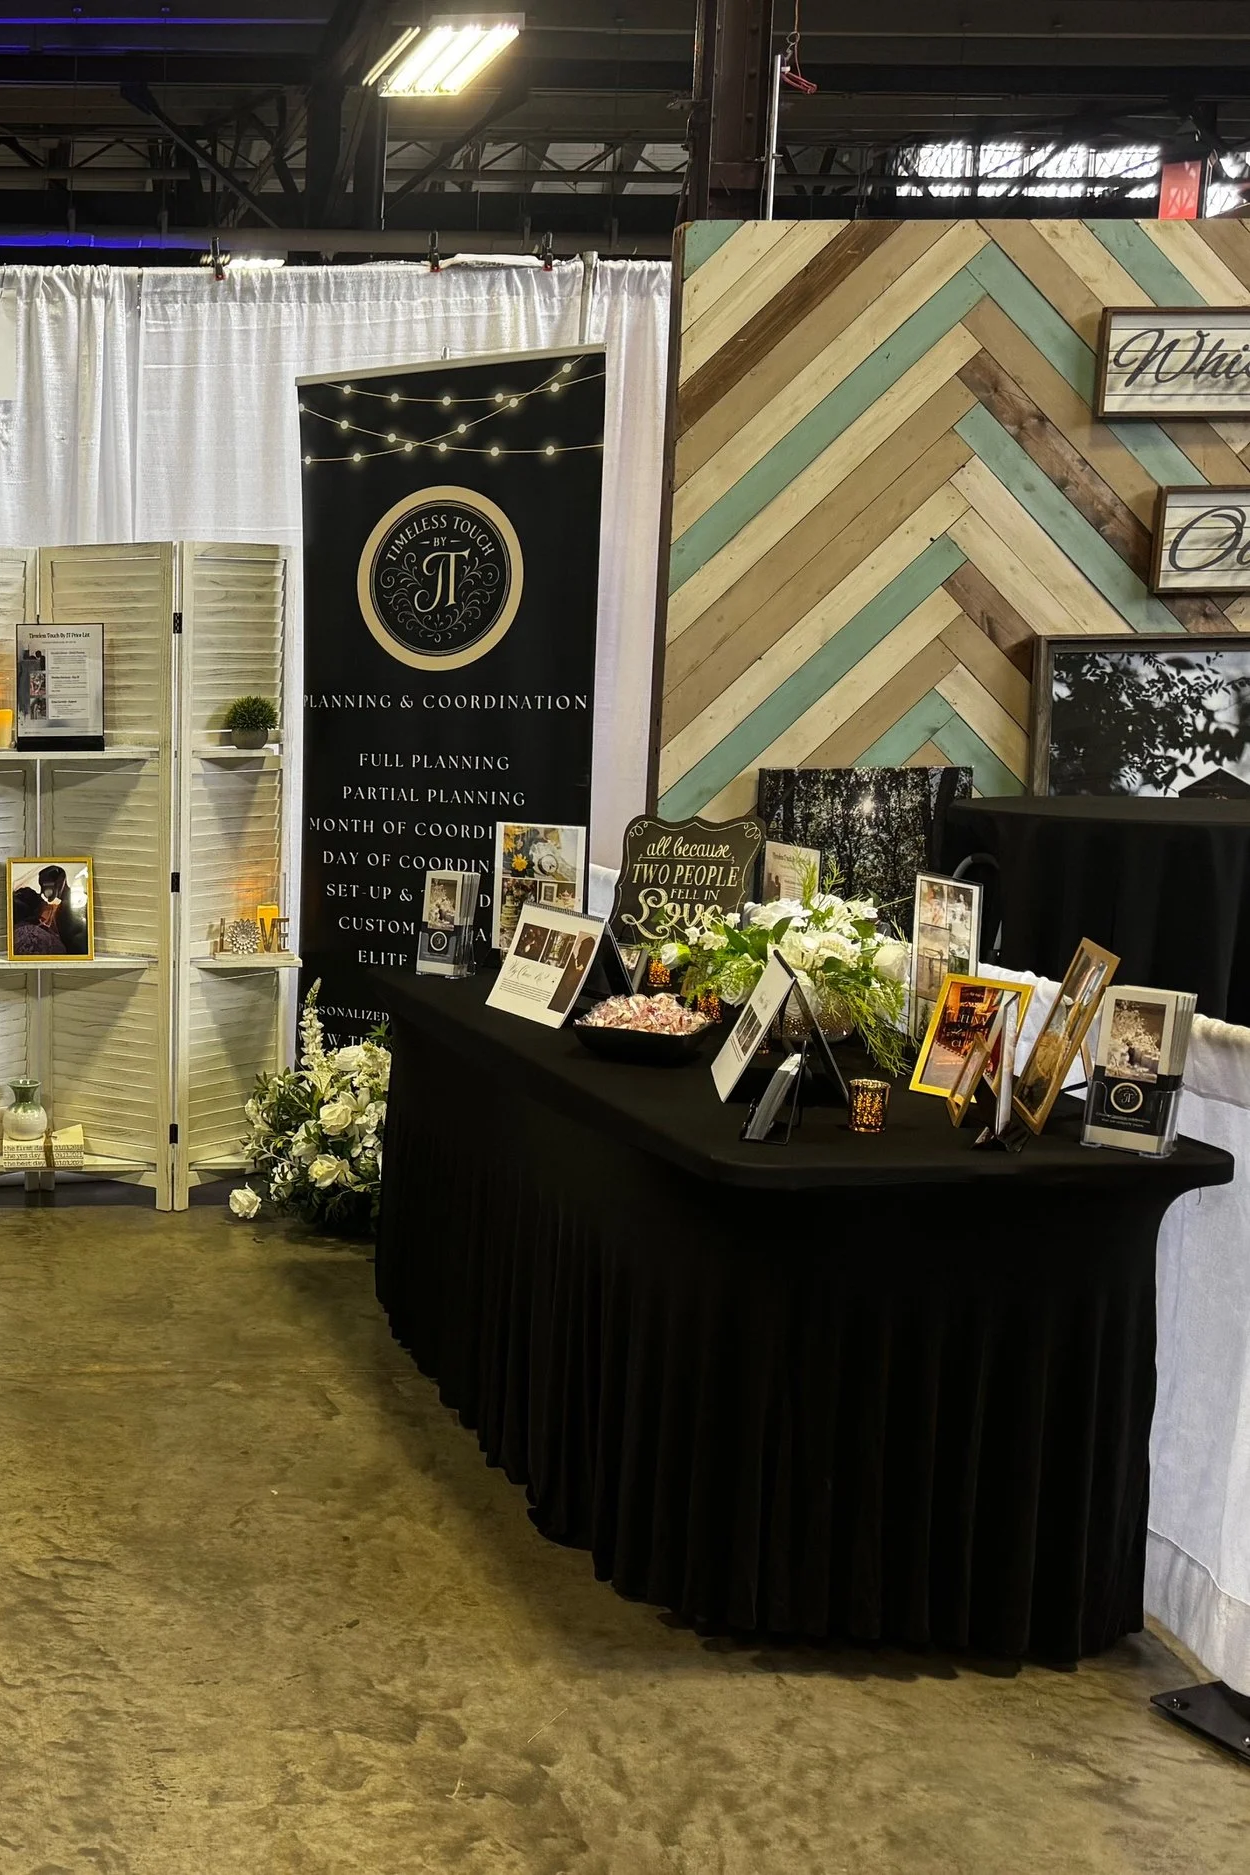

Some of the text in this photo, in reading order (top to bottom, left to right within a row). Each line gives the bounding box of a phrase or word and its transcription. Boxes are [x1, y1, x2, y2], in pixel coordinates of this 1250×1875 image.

[385, 514, 495, 561] TIMELESS TOUCH
[433, 536, 447, 547] BY
[303, 694, 588, 711] PLANNING & COORDINATION
[359, 753, 510, 771] FULL PLANNING
[343, 786, 526, 807] PARTIAL PLANNING
[310, 817, 374, 834] MONTH
[382, 820, 407, 835] OF
[646, 836, 732, 859] all because
[323, 850, 494, 874] DAY OF COORDIN
[632, 863, 739, 887] TWO PEOPLE
[326, 883, 392, 900] SET-UP
[399, 888, 413, 902] &
[670, 888, 720, 901] FELL IN
[338, 916, 415, 935] CUSTOM
